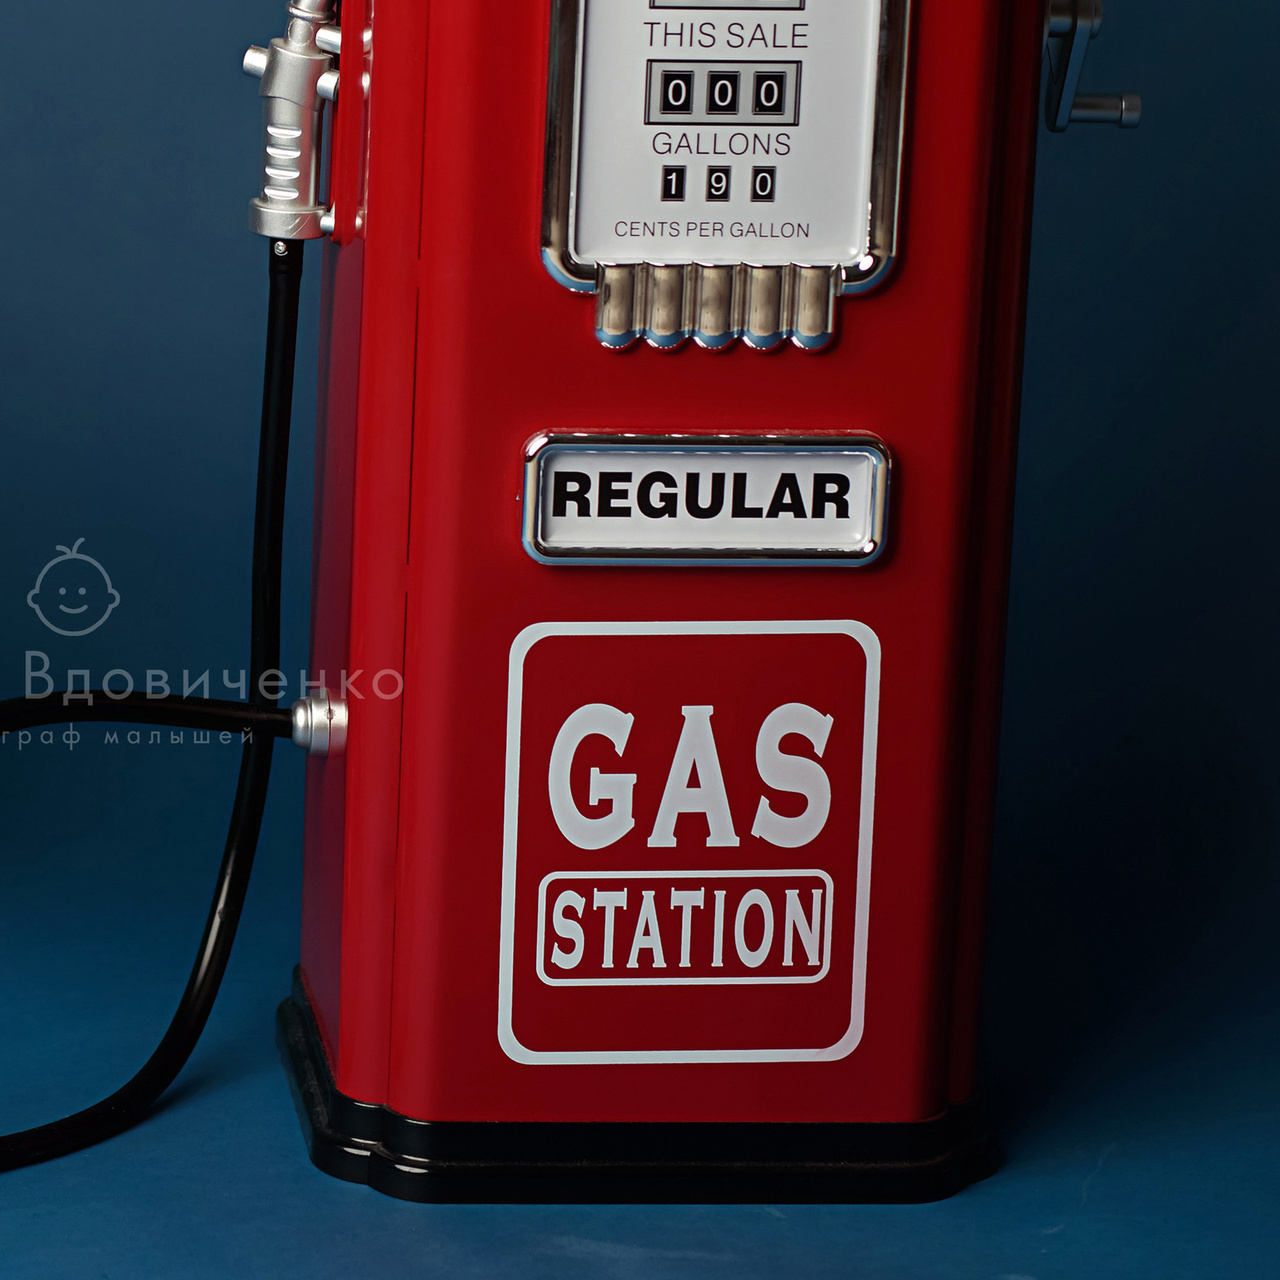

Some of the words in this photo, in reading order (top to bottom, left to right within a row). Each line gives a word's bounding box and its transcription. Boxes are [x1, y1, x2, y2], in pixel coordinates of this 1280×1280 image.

[643, 21, 716, 49] THIS
[726, 22, 809, 49] SALE
[652, 131, 791, 156] GALLONS
[614, 220, 681, 238] CENTS
[686, 221, 725, 238] PER
[729, 221, 810, 239] GALLON
[551, 470, 851, 520] REGULAR
[548, 702, 835, 851] GAS
[550, 886, 824, 970] STATION
